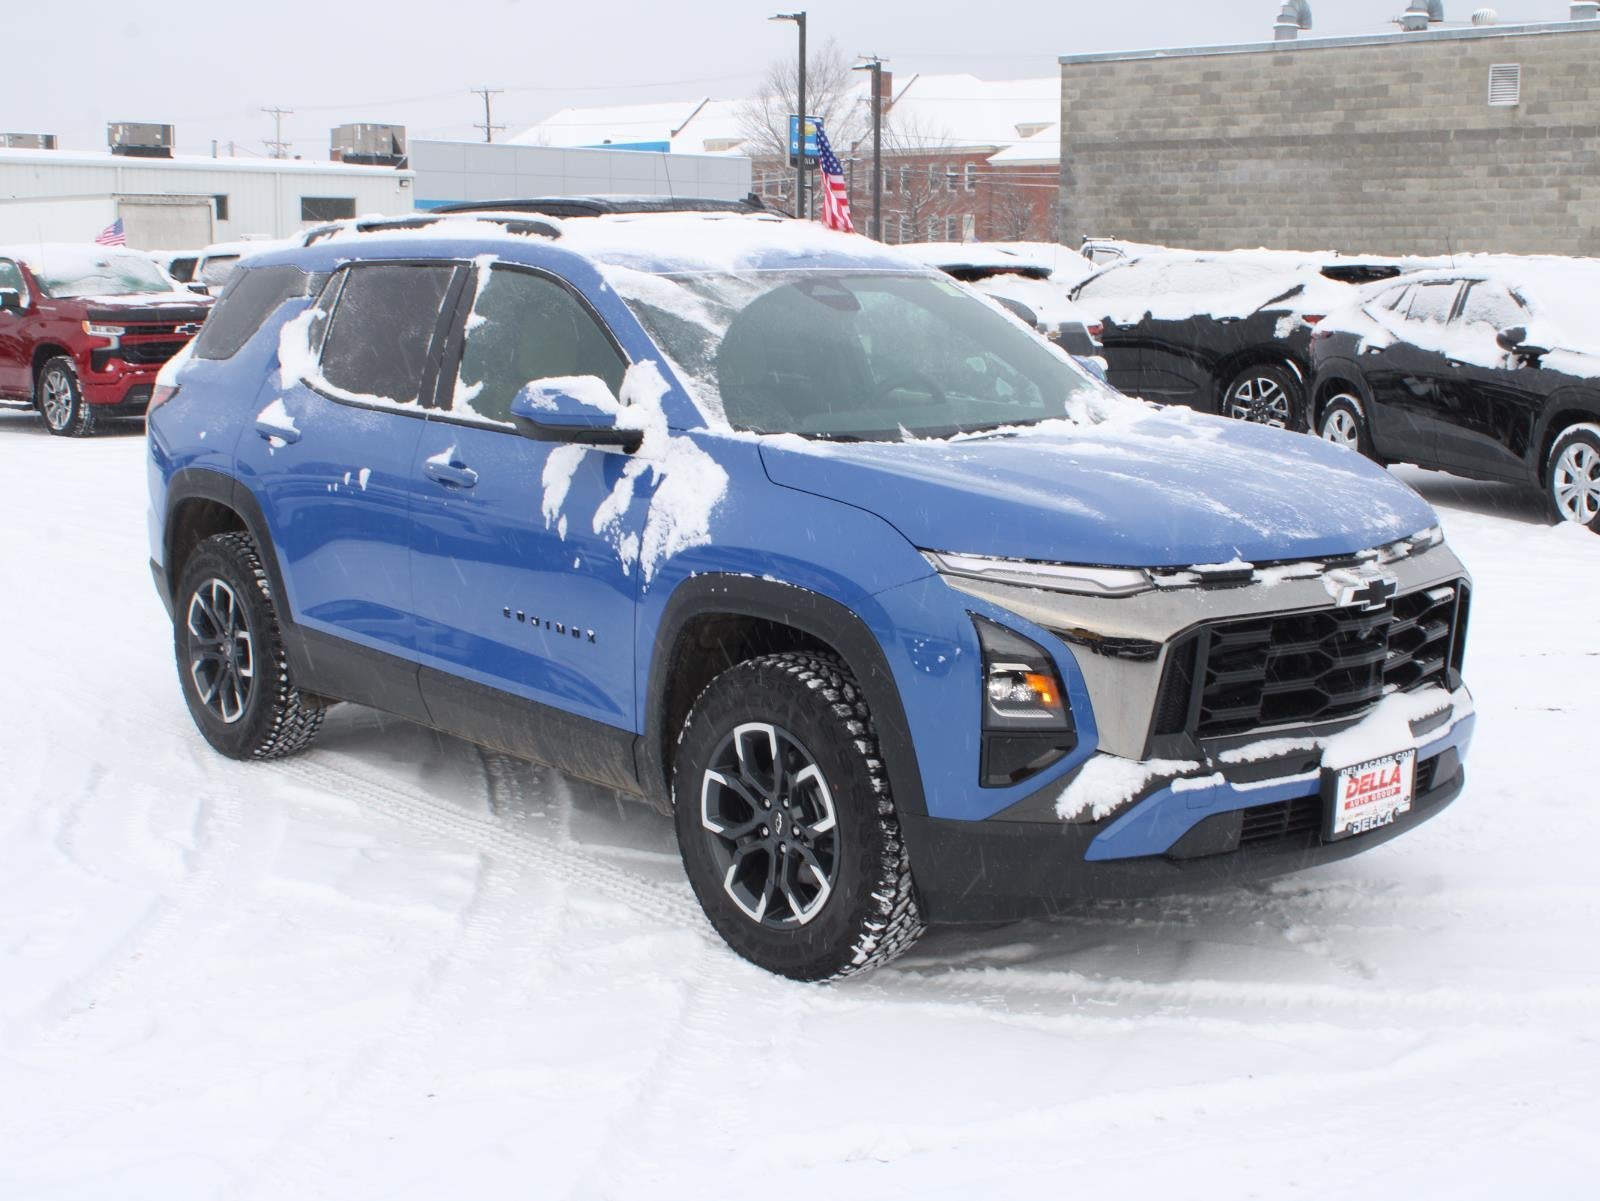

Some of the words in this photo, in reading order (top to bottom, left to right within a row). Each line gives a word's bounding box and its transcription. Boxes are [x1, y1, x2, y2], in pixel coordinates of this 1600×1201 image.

[1345, 767, 1401, 799] DELLA
[1349, 795, 1370, 809] AUTO
[1371, 787, 1396, 801] GROUP
[1352, 811, 1394, 835] DELLA
